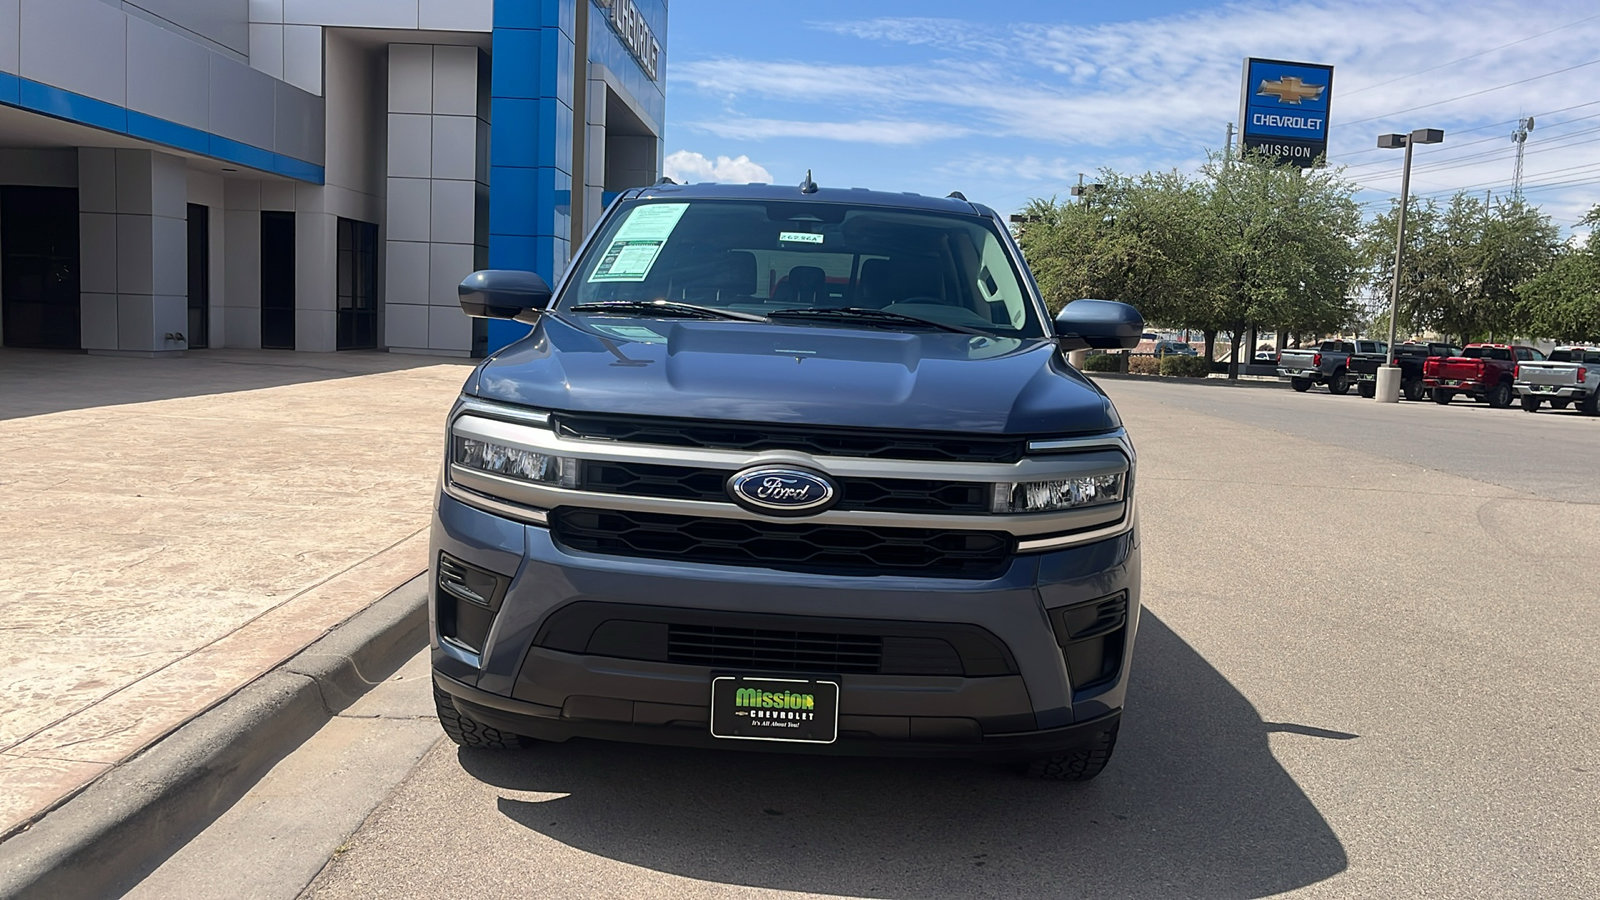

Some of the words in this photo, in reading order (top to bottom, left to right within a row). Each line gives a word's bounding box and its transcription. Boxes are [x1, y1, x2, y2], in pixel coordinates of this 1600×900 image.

[1253, 113, 1322, 130] CHEVROLET
[1260, 143, 1311, 157] MISSION
[757, 476, 810, 500] Ford
[735, 687, 814, 710] Mission
[750, 710, 814, 720] CHEVROLET
